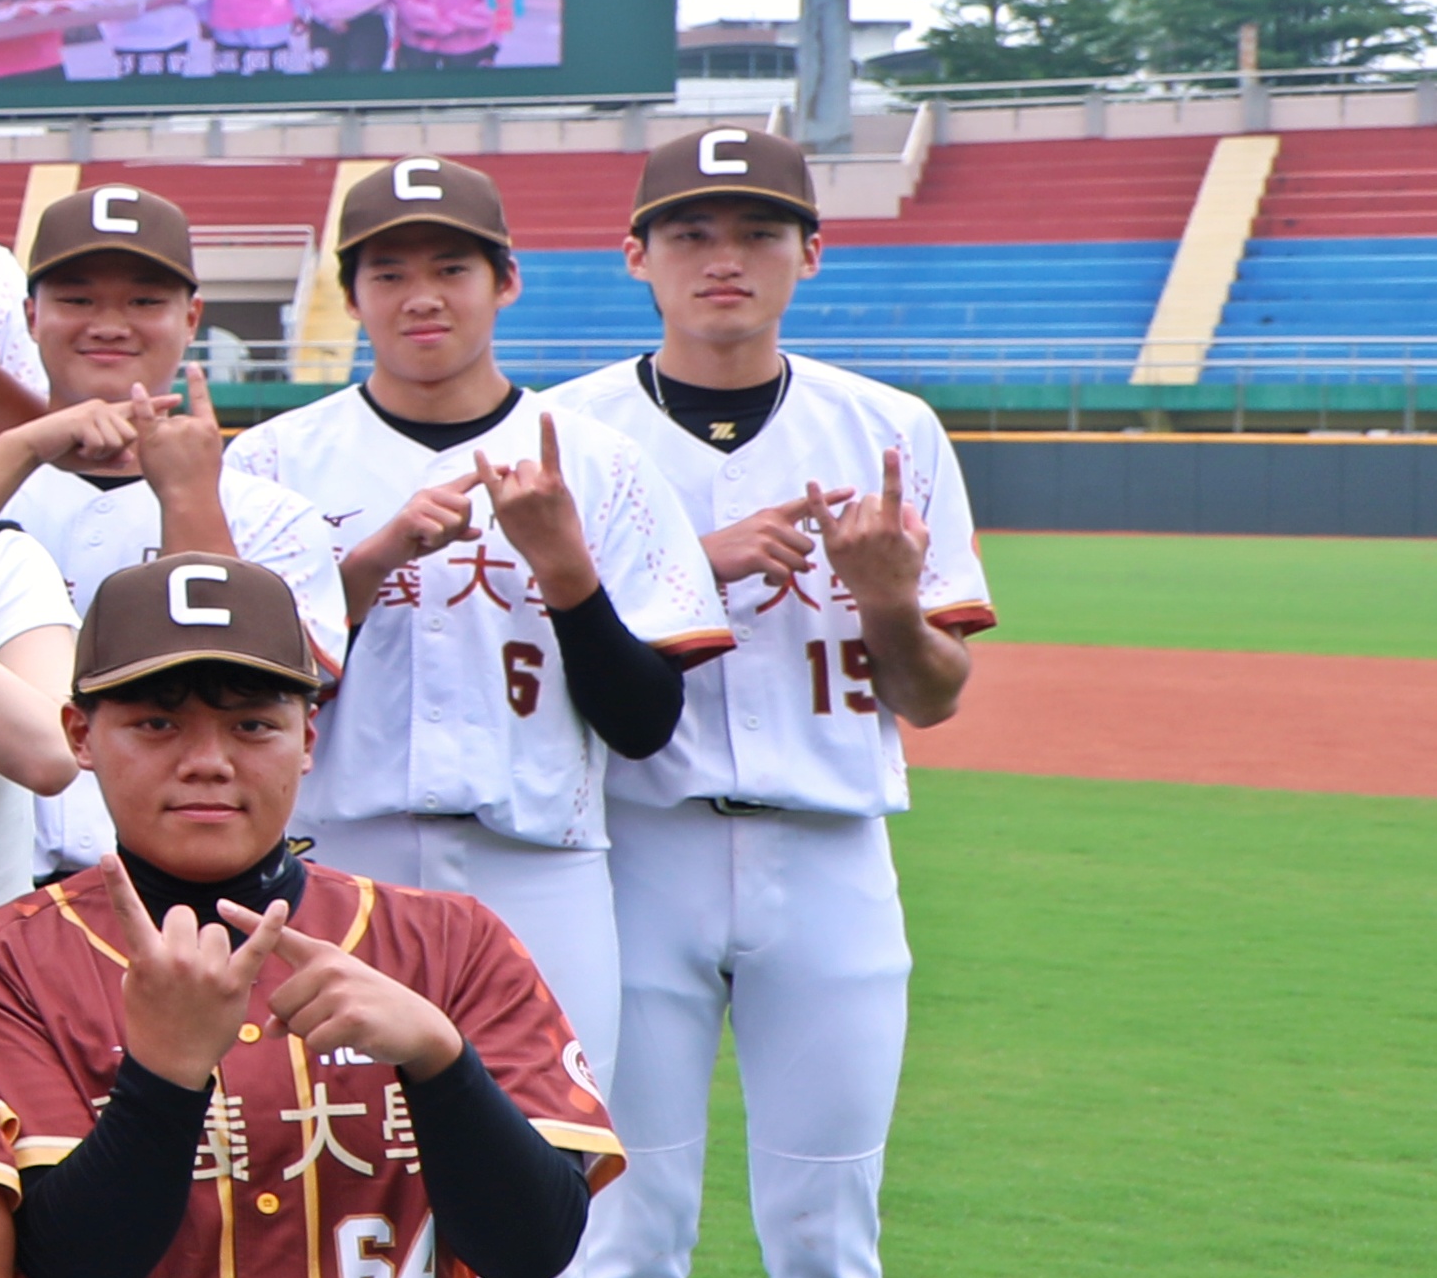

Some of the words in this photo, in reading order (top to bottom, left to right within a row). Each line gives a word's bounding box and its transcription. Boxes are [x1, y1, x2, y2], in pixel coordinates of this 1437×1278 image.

[393, 158, 443, 200] C
[698, 129, 749, 175] C
[92, 186, 139, 233] C
[168, 564, 232, 626] C
[502, 640, 544, 719] 6
[806, 638, 879, 716] 15
